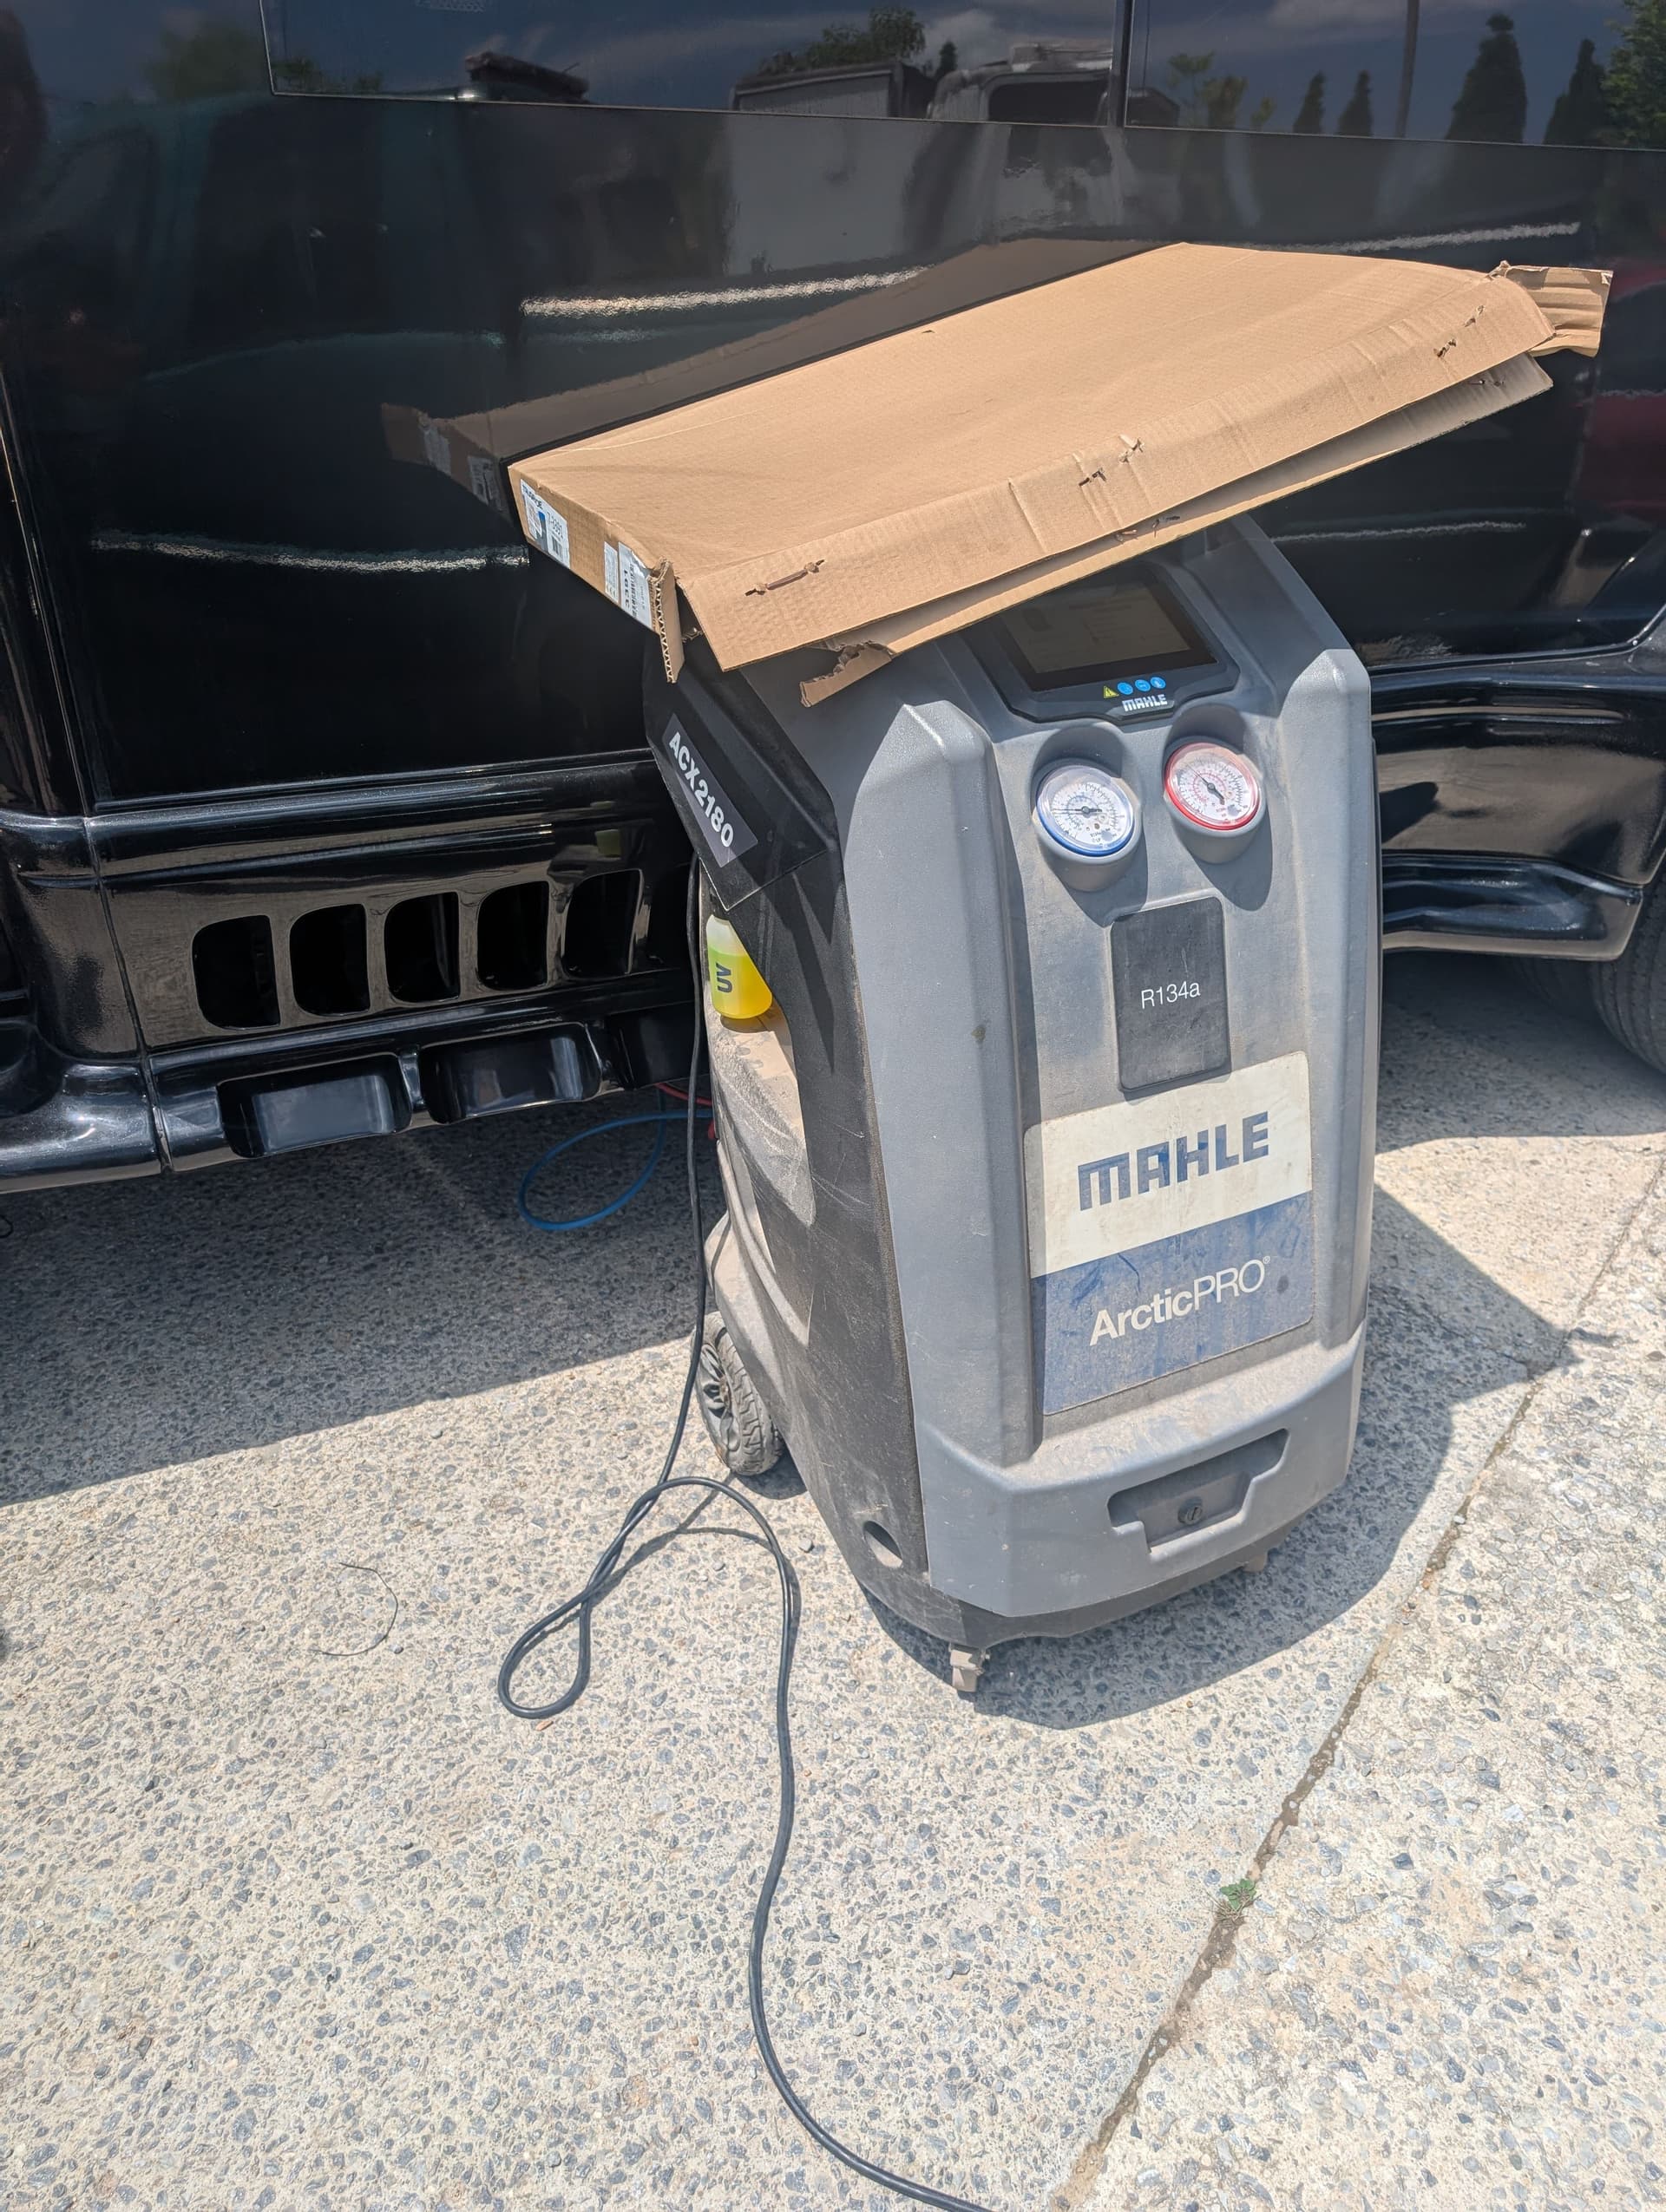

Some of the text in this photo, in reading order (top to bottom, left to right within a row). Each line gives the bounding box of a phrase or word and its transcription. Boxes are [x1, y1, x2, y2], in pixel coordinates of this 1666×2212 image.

[1122, 694, 1168, 711] MAHLE
[669, 731, 734, 847] ACX2180
[716, 962, 732, 993] UV
[1141, 981, 1201, 1010] R134a
[1078, 1110, 1269, 1211] MAHLE
